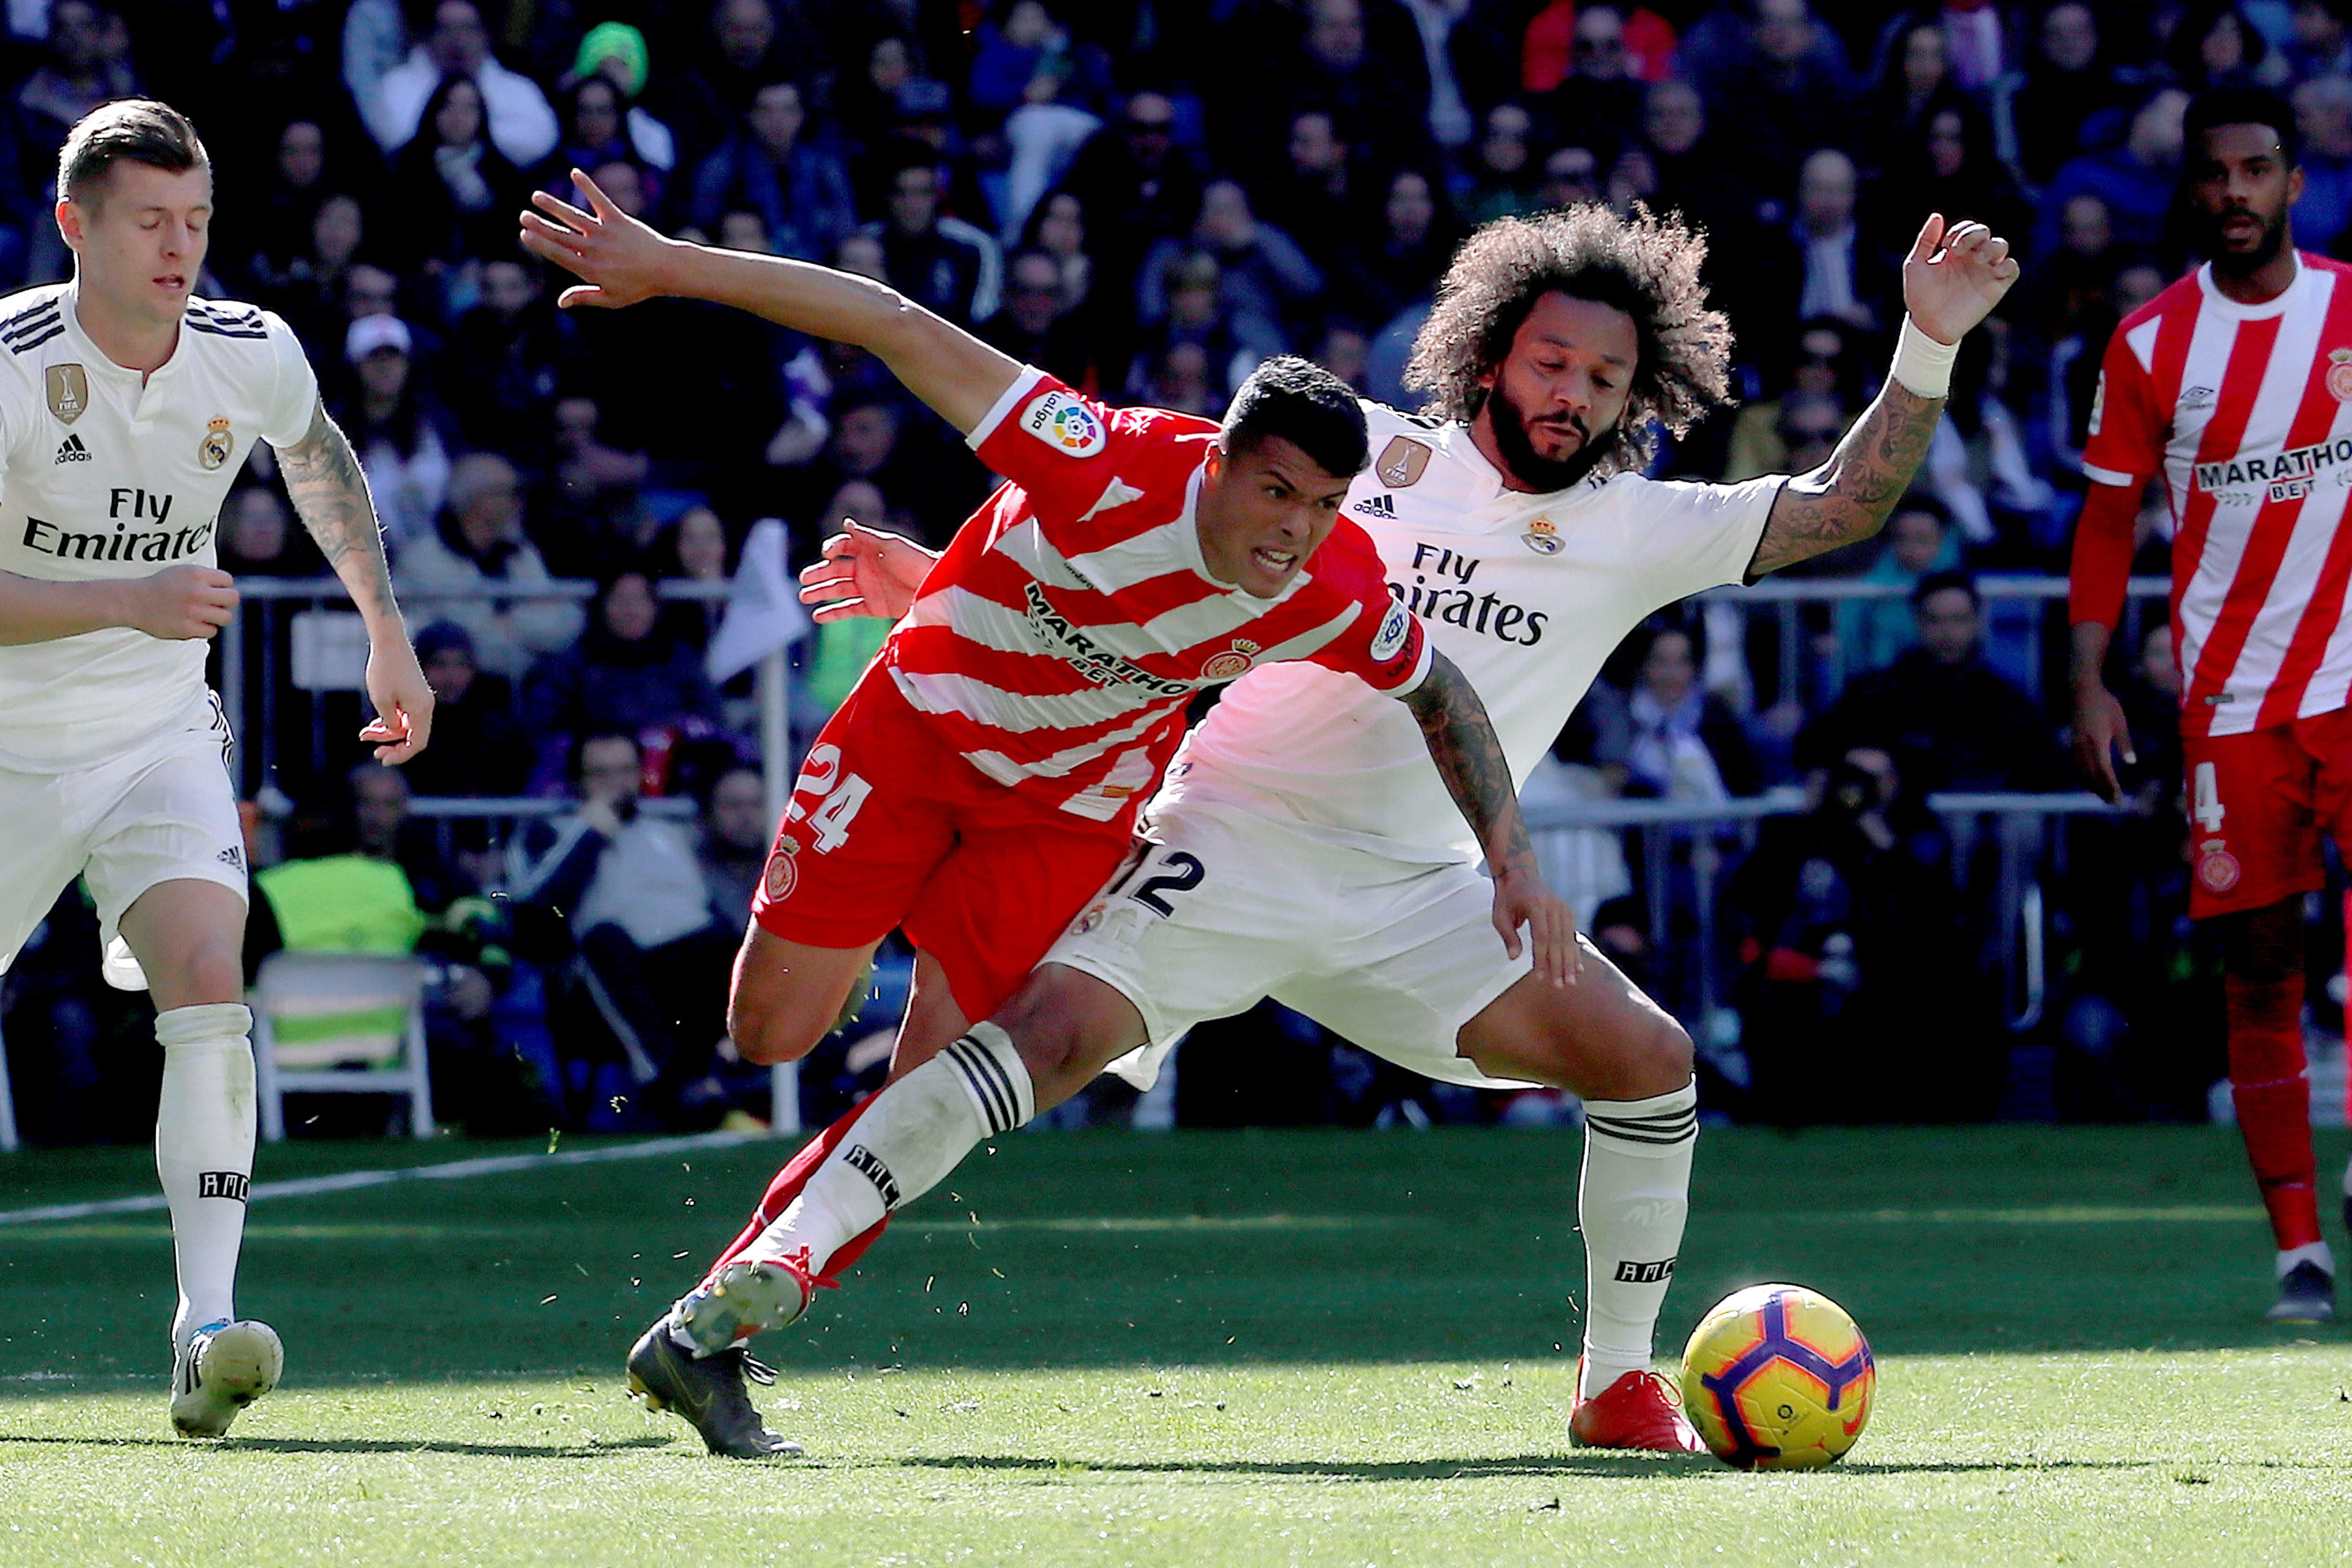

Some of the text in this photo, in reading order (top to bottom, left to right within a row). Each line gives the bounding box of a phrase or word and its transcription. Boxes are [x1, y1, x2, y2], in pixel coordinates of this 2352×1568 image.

[59, 402, 79, 410] FIFA
[55, 452, 92, 464] adidas
[2200, 440, 2352, 488] MARATHO
[1385, 468, 1406, 482] FIFA
[2272, 480, 2316, 500] BET
[109, 488, 173, 524] Fly
[1412, 542, 1480, 584] Fly
[1071, 659, 1123, 687] BET
[786, 741, 873, 855] 24
[2194, 761, 2226, 833] 4
